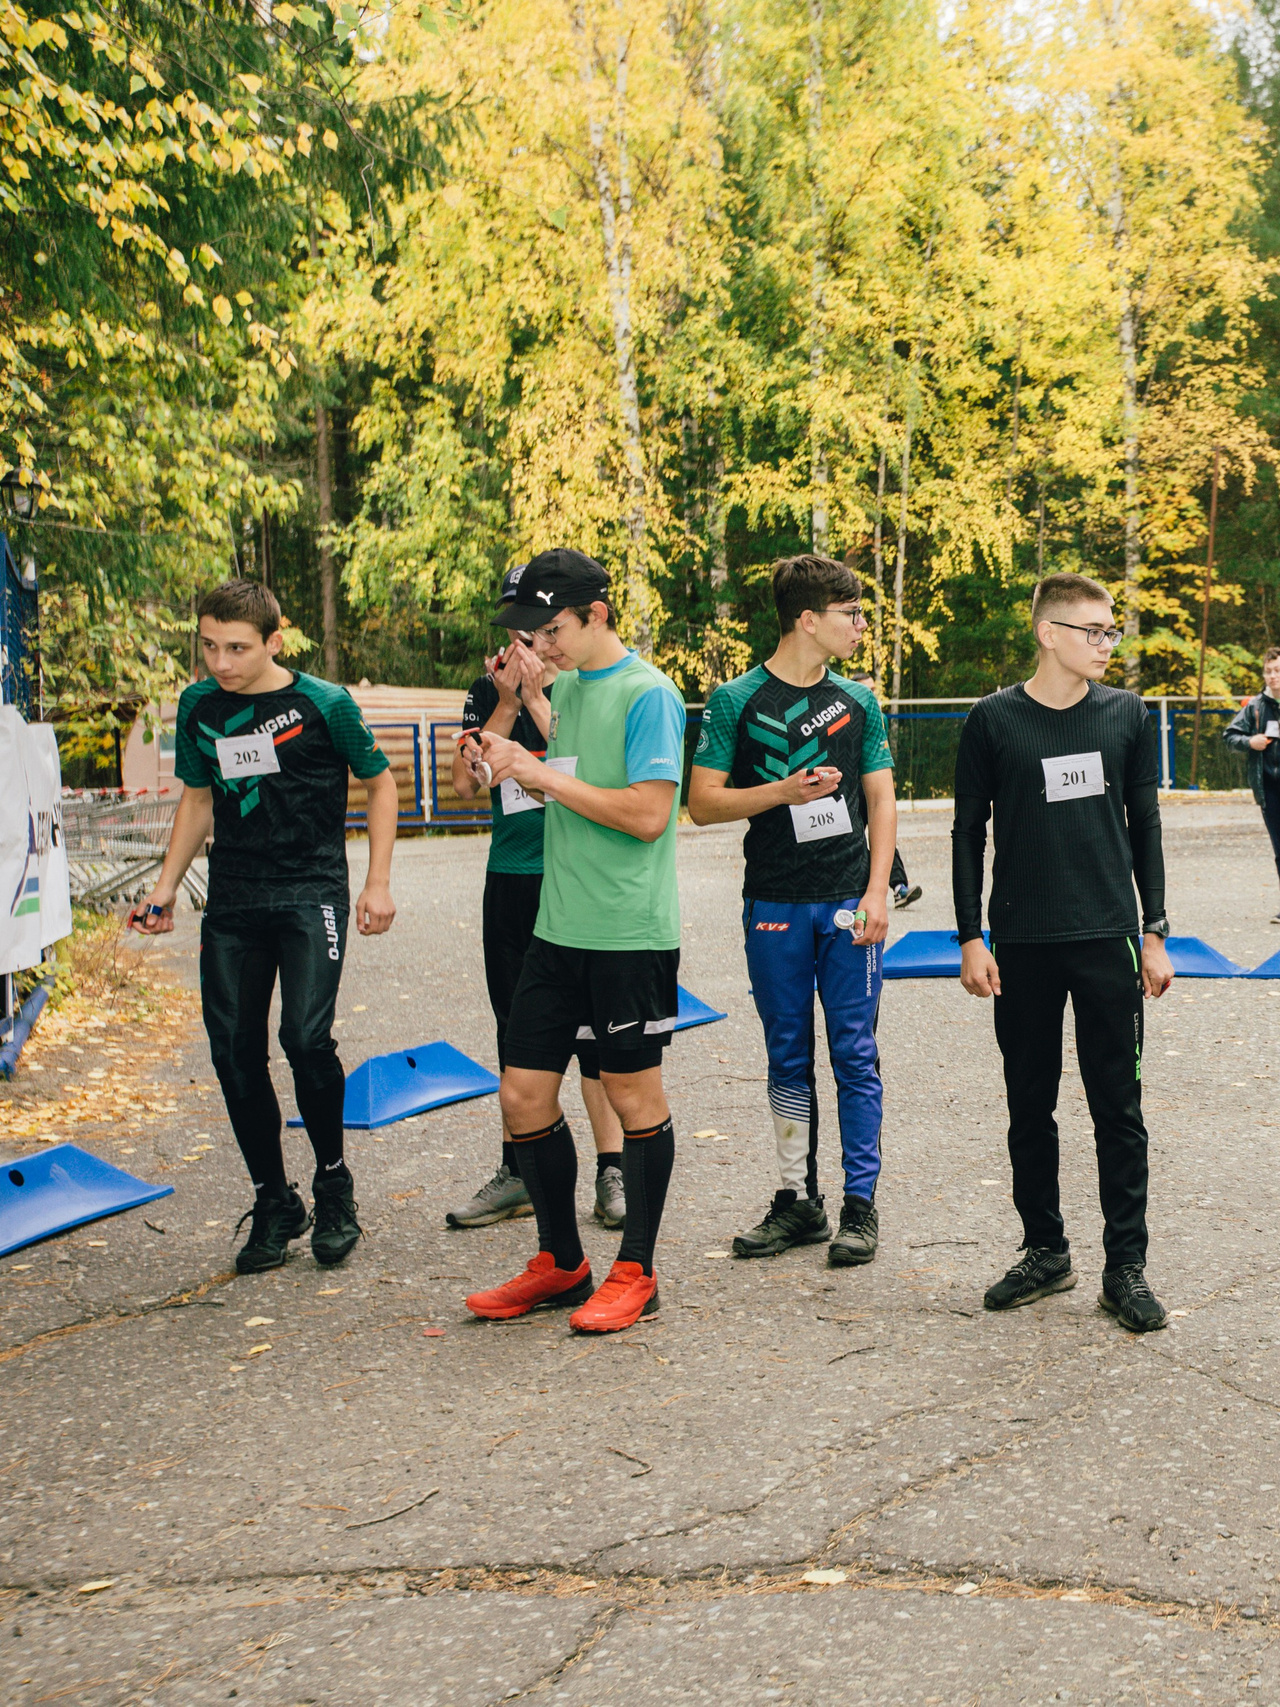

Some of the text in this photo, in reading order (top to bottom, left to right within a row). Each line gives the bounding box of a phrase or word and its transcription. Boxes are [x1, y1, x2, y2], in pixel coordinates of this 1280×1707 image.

[253, 708, 303, 735] UGRA
[800, 700, 847, 737] O-UGRA
[233, 750, 260, 766] 202
[1062, 769, 1087, 787] 201
[514, 788, 529, 801] 20
[808, 811, 835, 829] 208
